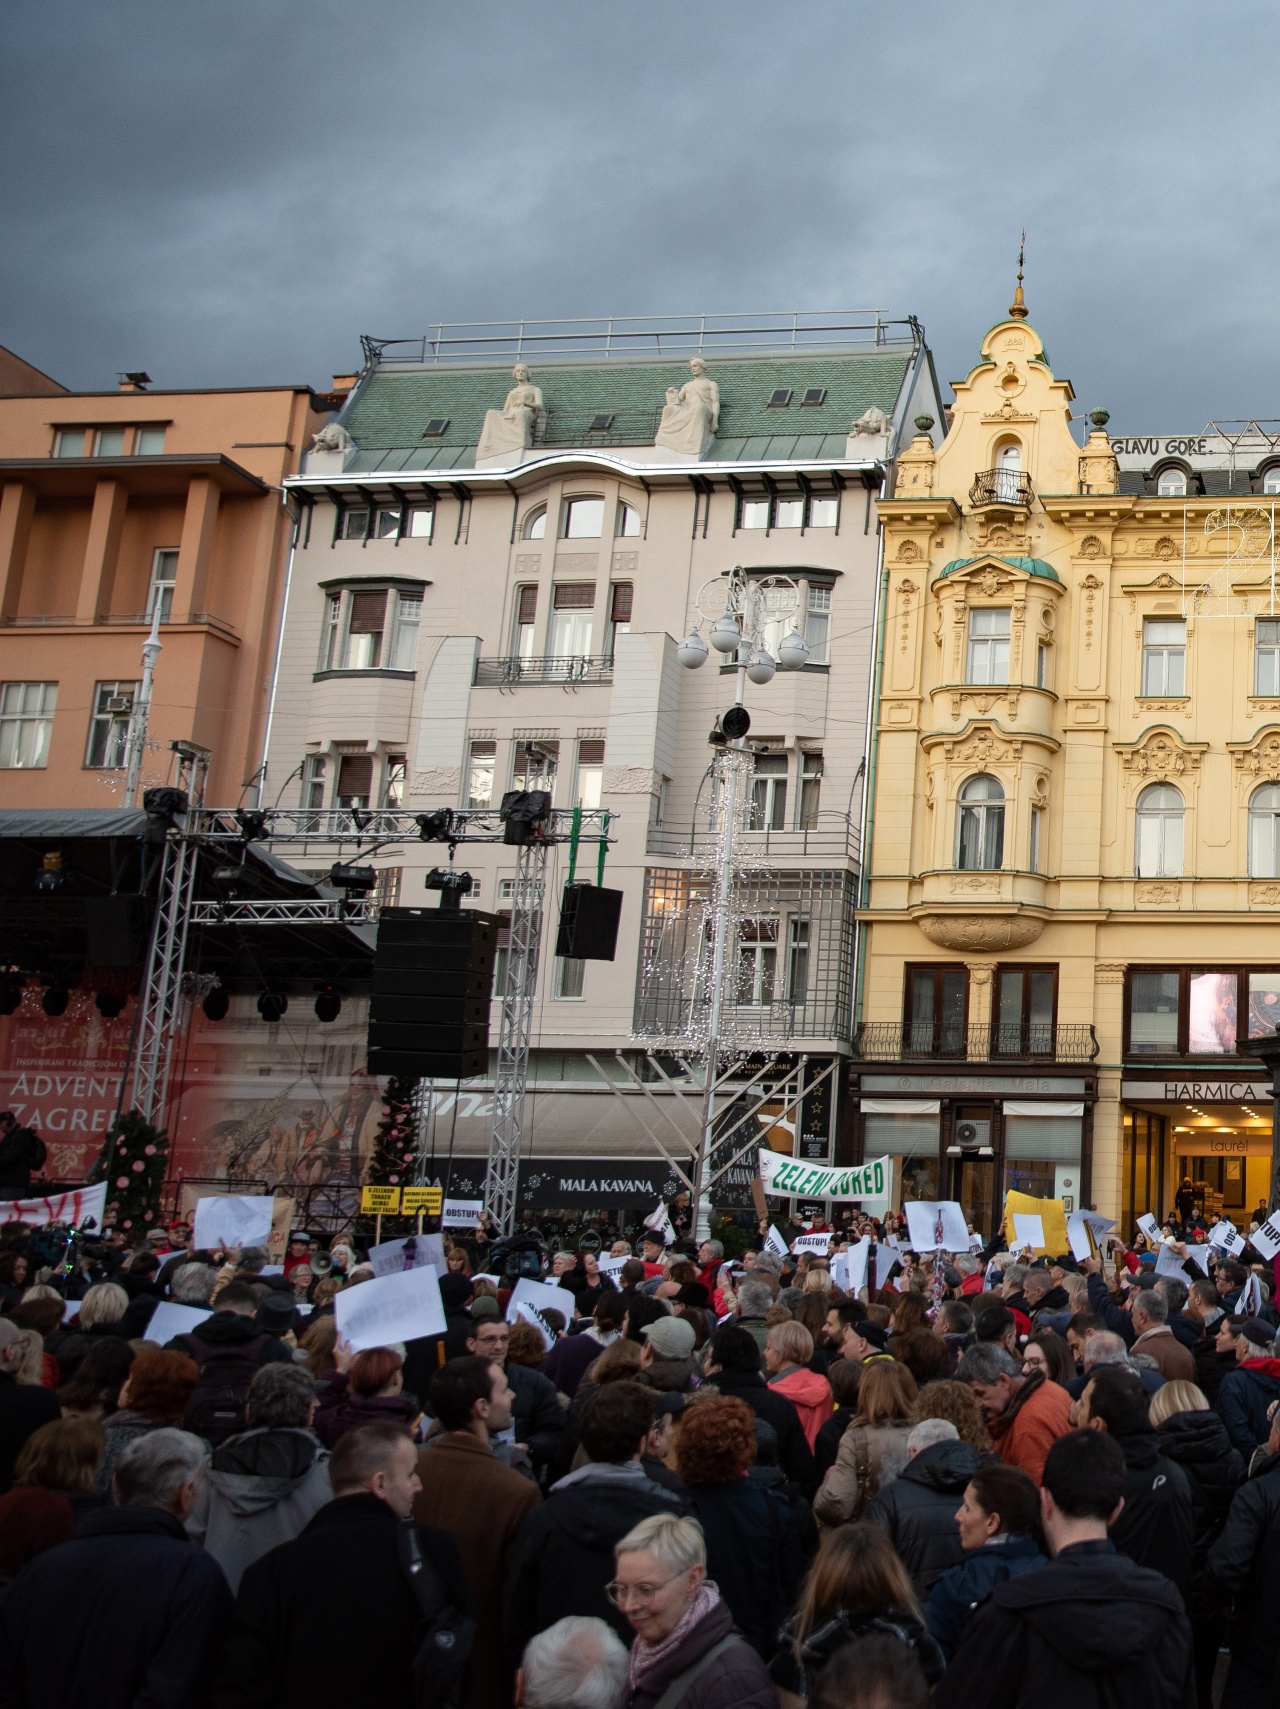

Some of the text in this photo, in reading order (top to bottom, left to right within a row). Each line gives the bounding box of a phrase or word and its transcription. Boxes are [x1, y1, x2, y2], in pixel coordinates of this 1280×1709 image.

[1111, 439, 1159, 456] GLAVU
[10, 1073, 125, 1098] ADVENT
[1164, 1083, 1257, 1100] HARMICA
[1210, 1138, 1249, 1152] Laurèl
[560, 1178, 654, 1193] MALA KAVANA
[772, 1161, 834, 1196] ZELENI
[446, 1208, 480, 1218] ODSTUPI
